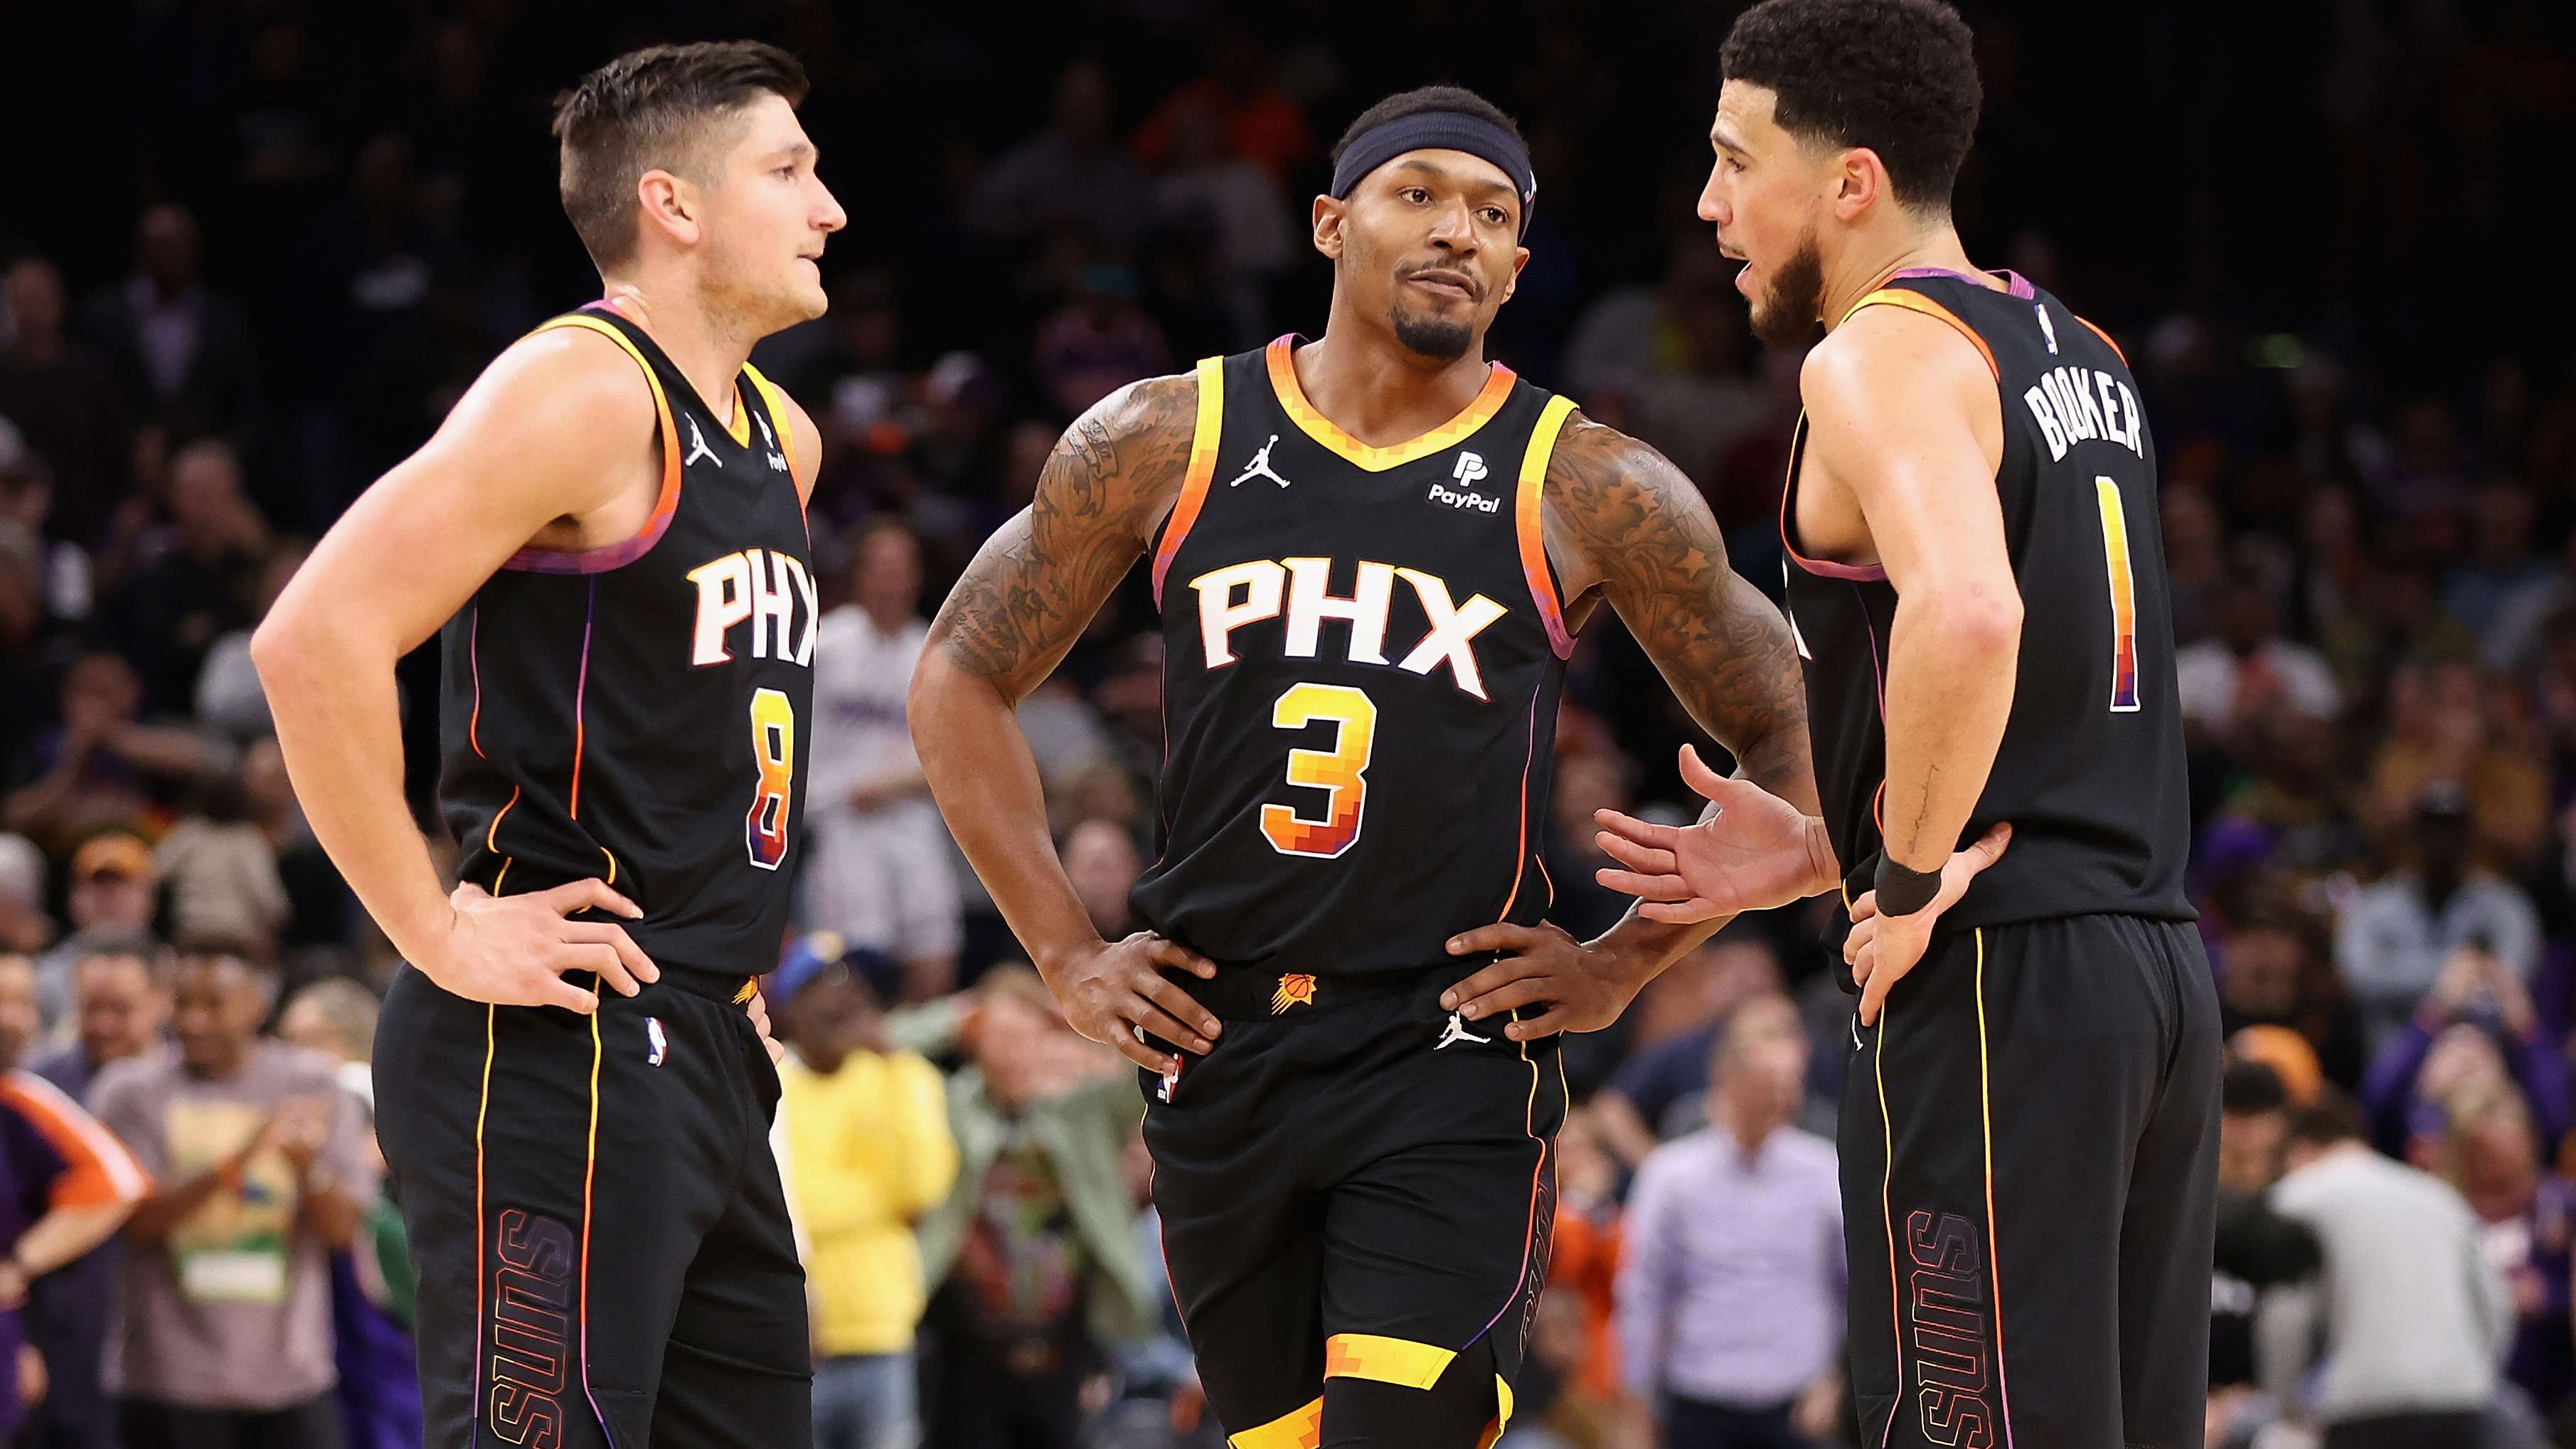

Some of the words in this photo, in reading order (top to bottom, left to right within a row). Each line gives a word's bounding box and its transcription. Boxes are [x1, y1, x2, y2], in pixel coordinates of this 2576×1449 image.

[1428, 484, 1501, 513] PayPal
[2023, 366, 2144, 463] BOOKER
[685, 547, 819, 668] PHX
[1188, 557, 1509, 703] PHX
[2095, 475, 2141, 713] 1
[746, 687, 794, 871] 8
[1260, 682, 1378, 859] 3
[491, 1209, 574, 1449] SUNS
[1907, 1209, 1993, 1449] SUNS
